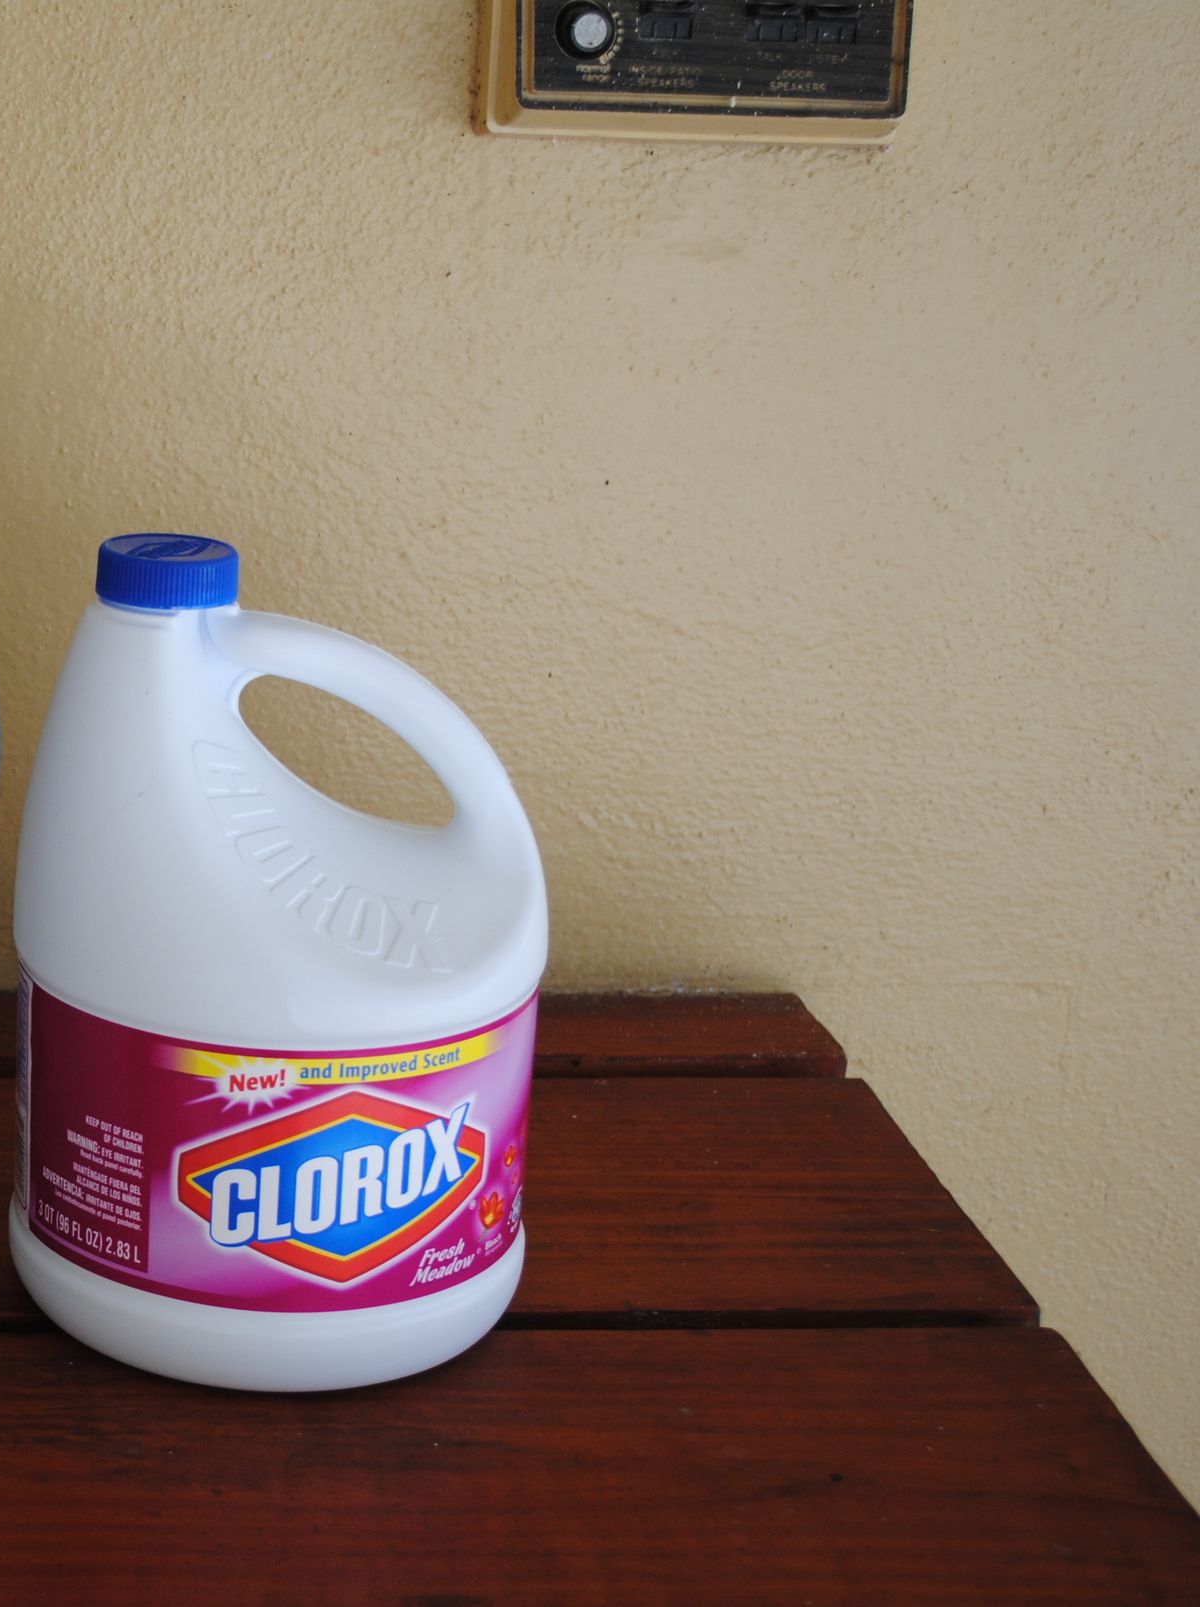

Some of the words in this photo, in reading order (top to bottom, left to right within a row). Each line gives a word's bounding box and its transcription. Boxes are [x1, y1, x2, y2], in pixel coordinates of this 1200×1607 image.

[769, 81, 826, 92] SPEAKERS
[300, 1064, 332, 1079] and
[339, 1056, 417, 1080] Improved
[423, 1047, 461, 1069] Scent
[229, 1069, 286, 1093] New!
[86, 1114, 99, 1127] KEEP
[100, 1121, 112, 1132] OUT
[113, 1125, 121, 1135] OF
[122, 1128, 143, 1142] REACH
[66, 1128, 100, 1154] WARNING:
[101, 1147, 112, 1159] EYE
[103, 1133, 111, 1143] OF
[112, 1136, 144, 1154] CHILDREN.
[109, 1177, 128, 1191] FUERA
[129, 1184, 141, 1196] DEL
[211, 1103, 469, 1246] CLOROX
[101, 1185, 109, 1195] DE
[110, 1188, 120, 1200] LOS
[115, 1205, 124, 1215] DE
[38, 1199, 43, 1216] 3
[44, 1203, 55, 1224] QT
[56, 1211, 69, 1234] (96
[72, 1220, 82, 1241] FL
[85, 1227, 103, 1252] OZ)
[105, 1236, 130, 1260] 2.83
[134, 1245, 141, 1264] L
[419, 1238, 465, 1267] Fresh
[409, 1253, 475, 1287] Meadow
